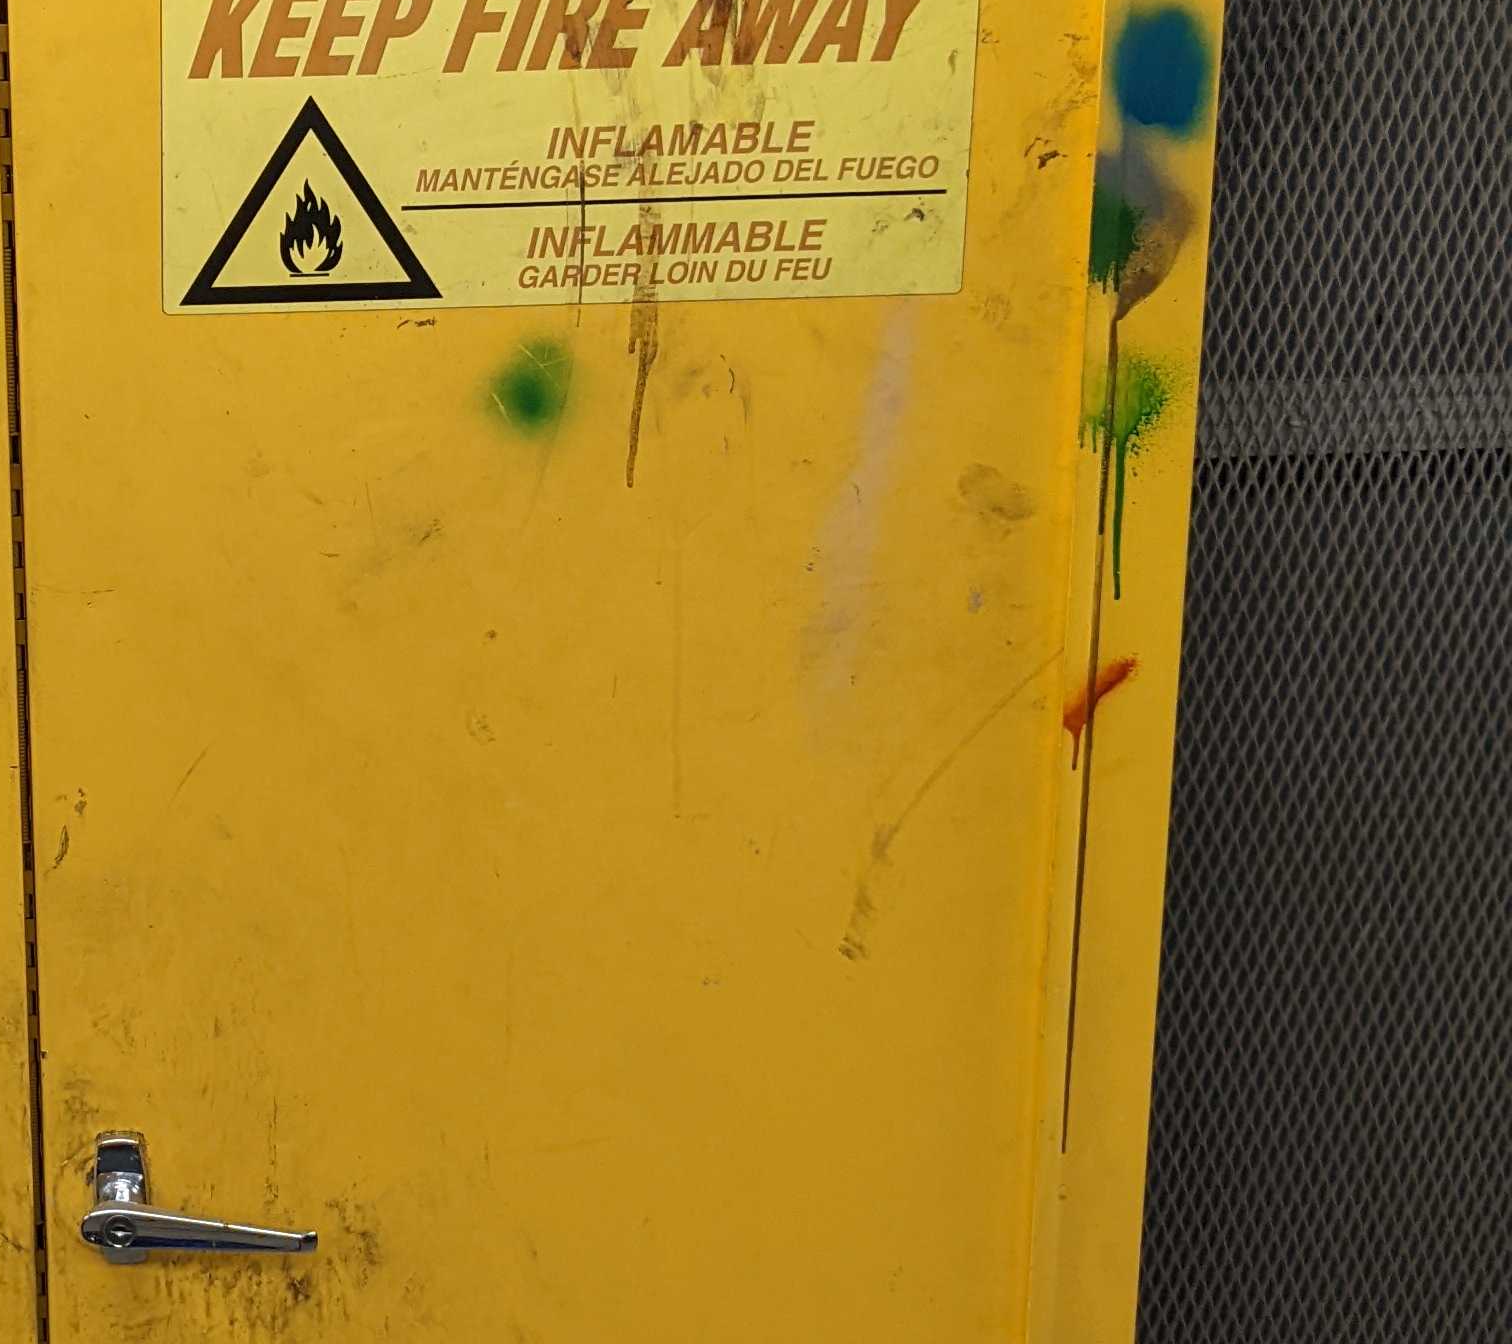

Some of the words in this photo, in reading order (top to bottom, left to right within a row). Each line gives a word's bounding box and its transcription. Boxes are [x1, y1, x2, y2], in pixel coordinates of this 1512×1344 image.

[547, 119, 816, 160] INFLAMABLE
[415, 157, 621, 194] MANTÉNGASE
[625, 160, 767, 189] ALEJADO
[771, 157, 833, 184] DEL
[837, 155, 940, 182] FUEGO
[527, 218, 827, 259] INFLAMMABLE
[518, 260, 641, 290] GARDER
[647, 260, 721, 287] LOIN
[726, 258, 768, 284] DU
[773, 256, 833, 283] FEU
